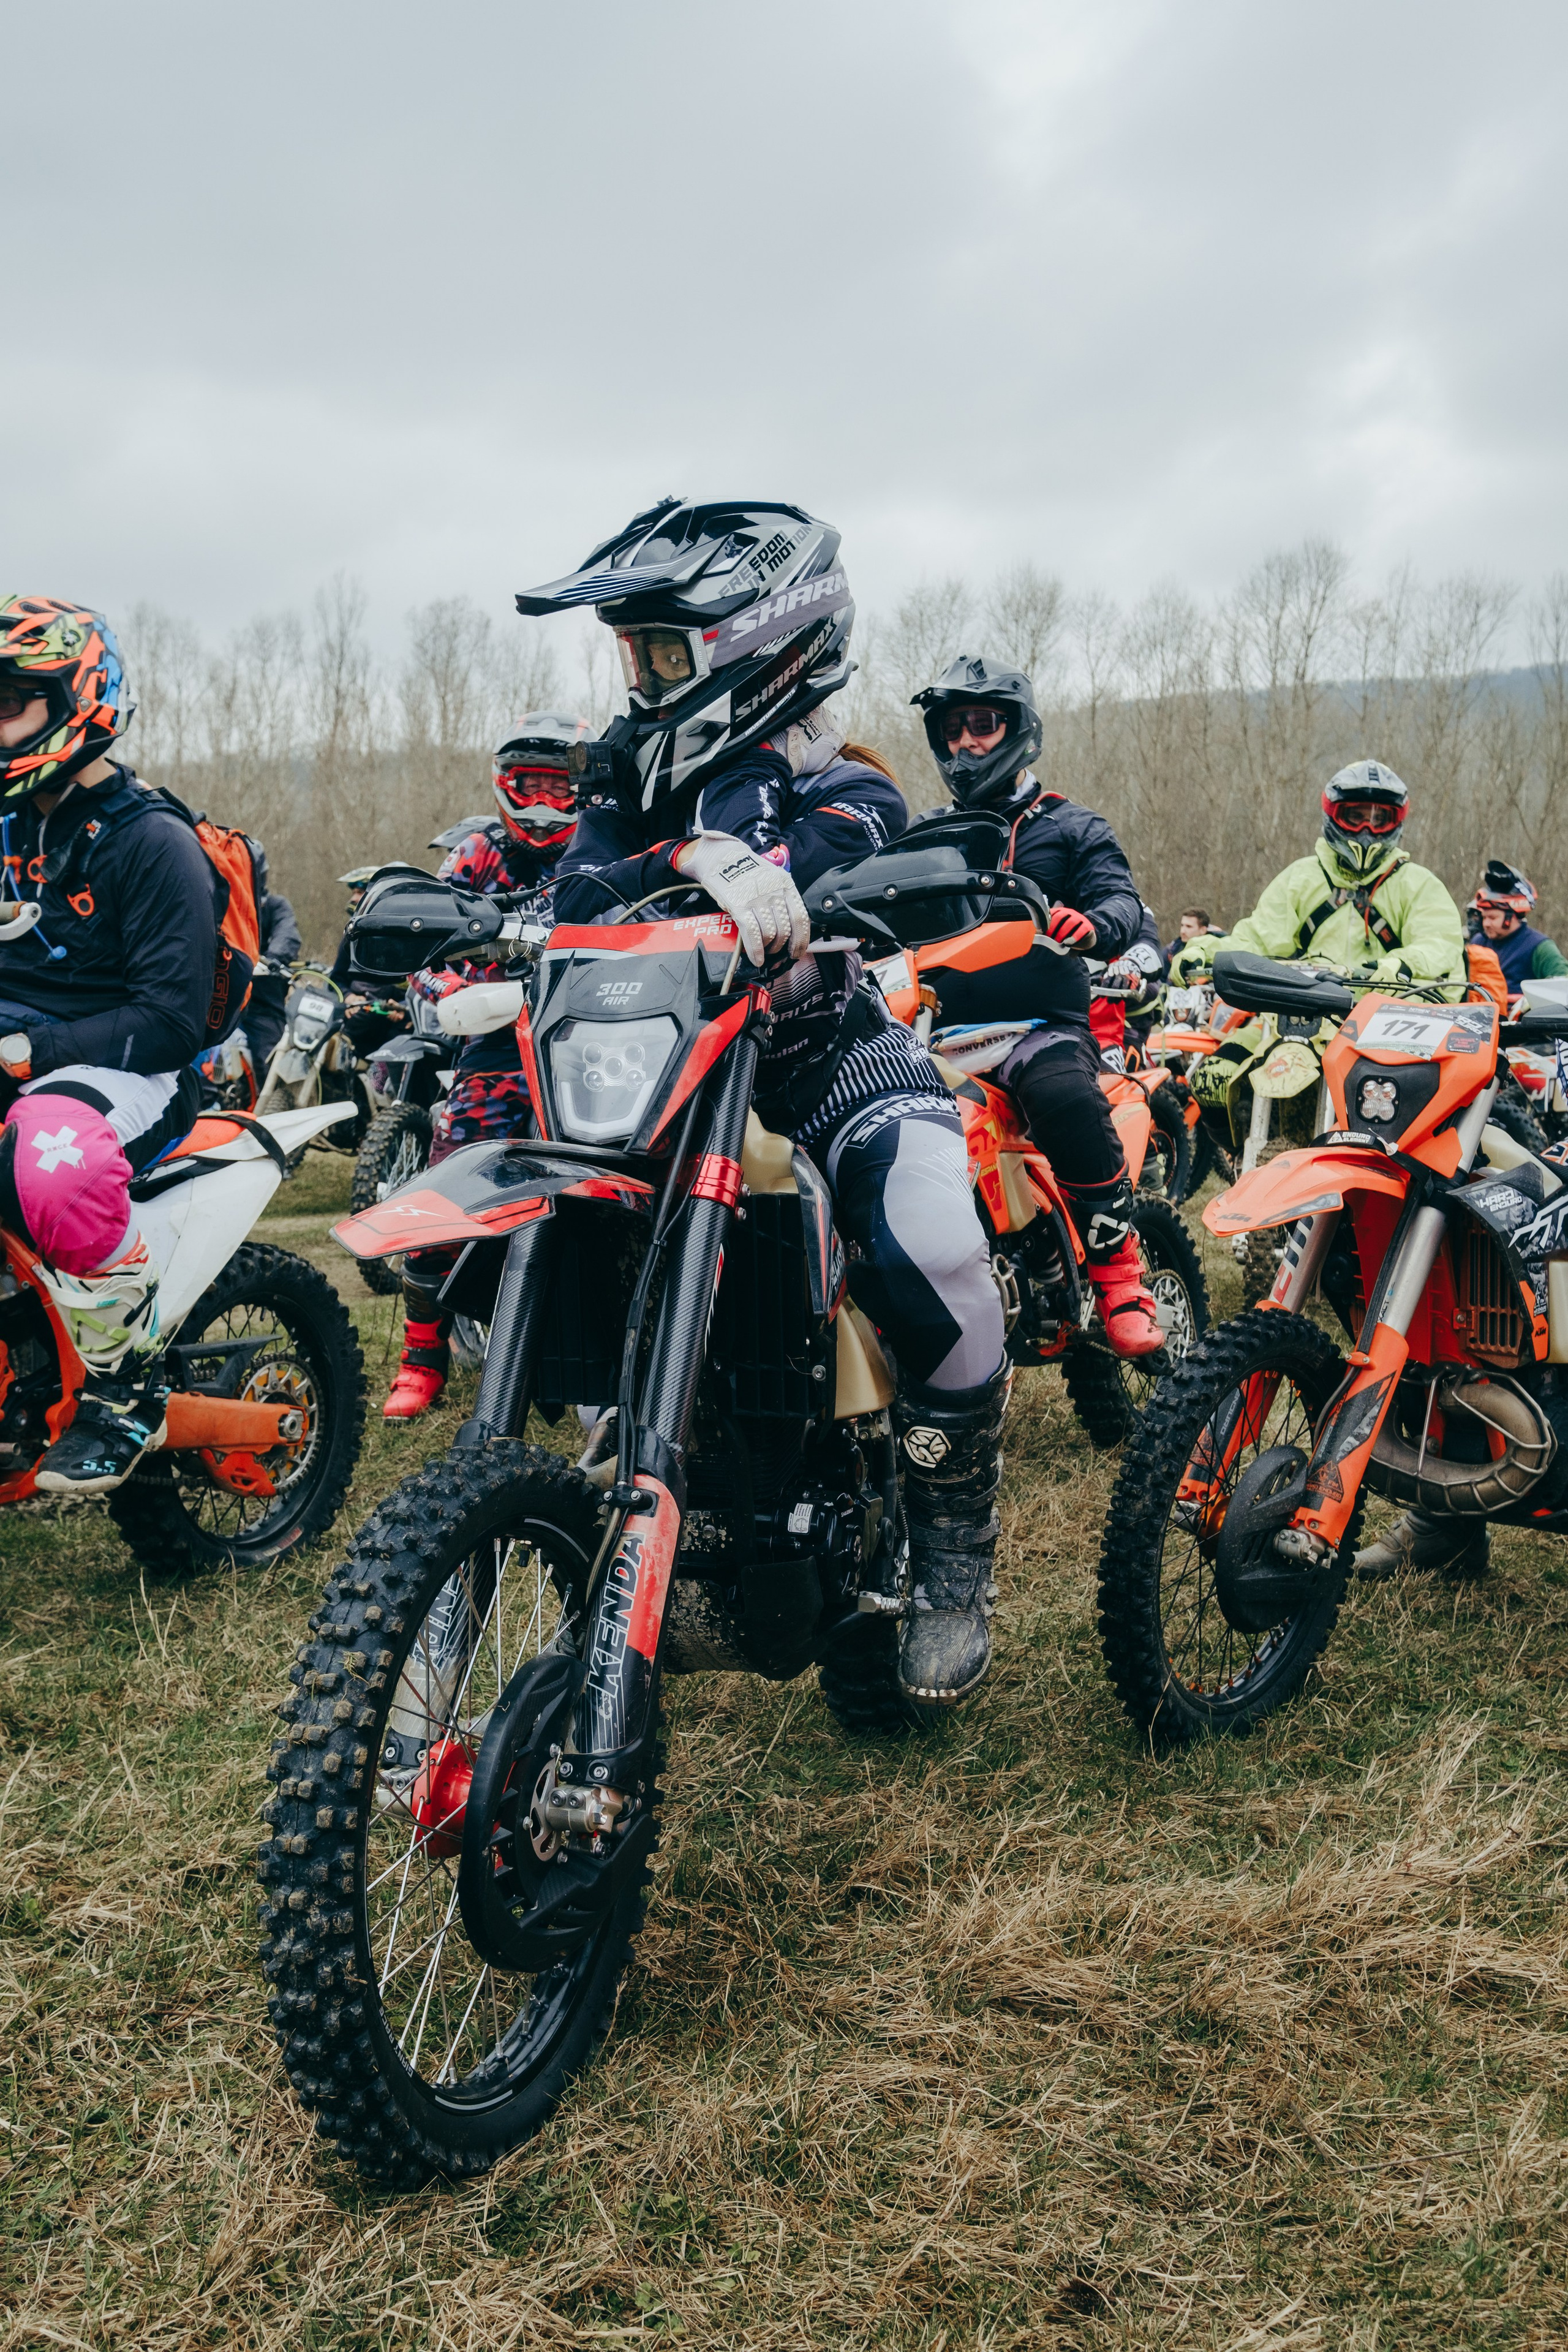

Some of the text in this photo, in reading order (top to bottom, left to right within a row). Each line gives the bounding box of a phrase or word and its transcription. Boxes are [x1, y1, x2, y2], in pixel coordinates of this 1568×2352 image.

[717, 529, 788, 598] FREEDOM
[748, 525, 812, 590] IN MOTION
[694, 635, 704, 660] MOTION
[735, 616, 837, 723] SHARMAX
[745, 706, 776, 736] ADVENTURE
[775, 688, 796, 710] AWAITS
[673, 913, 732, 930] EXPER
[693, 923, 731, 937] PRO
[596, 982, 643, 997] 300
[602, 996, 630, 1005] AIR
[1381, 1019, 1430, 1039] 171
[1342, 1131, 1371, 1140] ENDURO
[1479, 1189, 1515, 1208] HARD
[1490, 1196, 1523, 1212] ENDURO
[1216, 1213, 1253, 1223] KTM
[1535, 1326, 1547, 1337] KTM
[587, 1531, 646, 1698] KENDA
[379, 2006, 413, 2078] GIANT RACE
